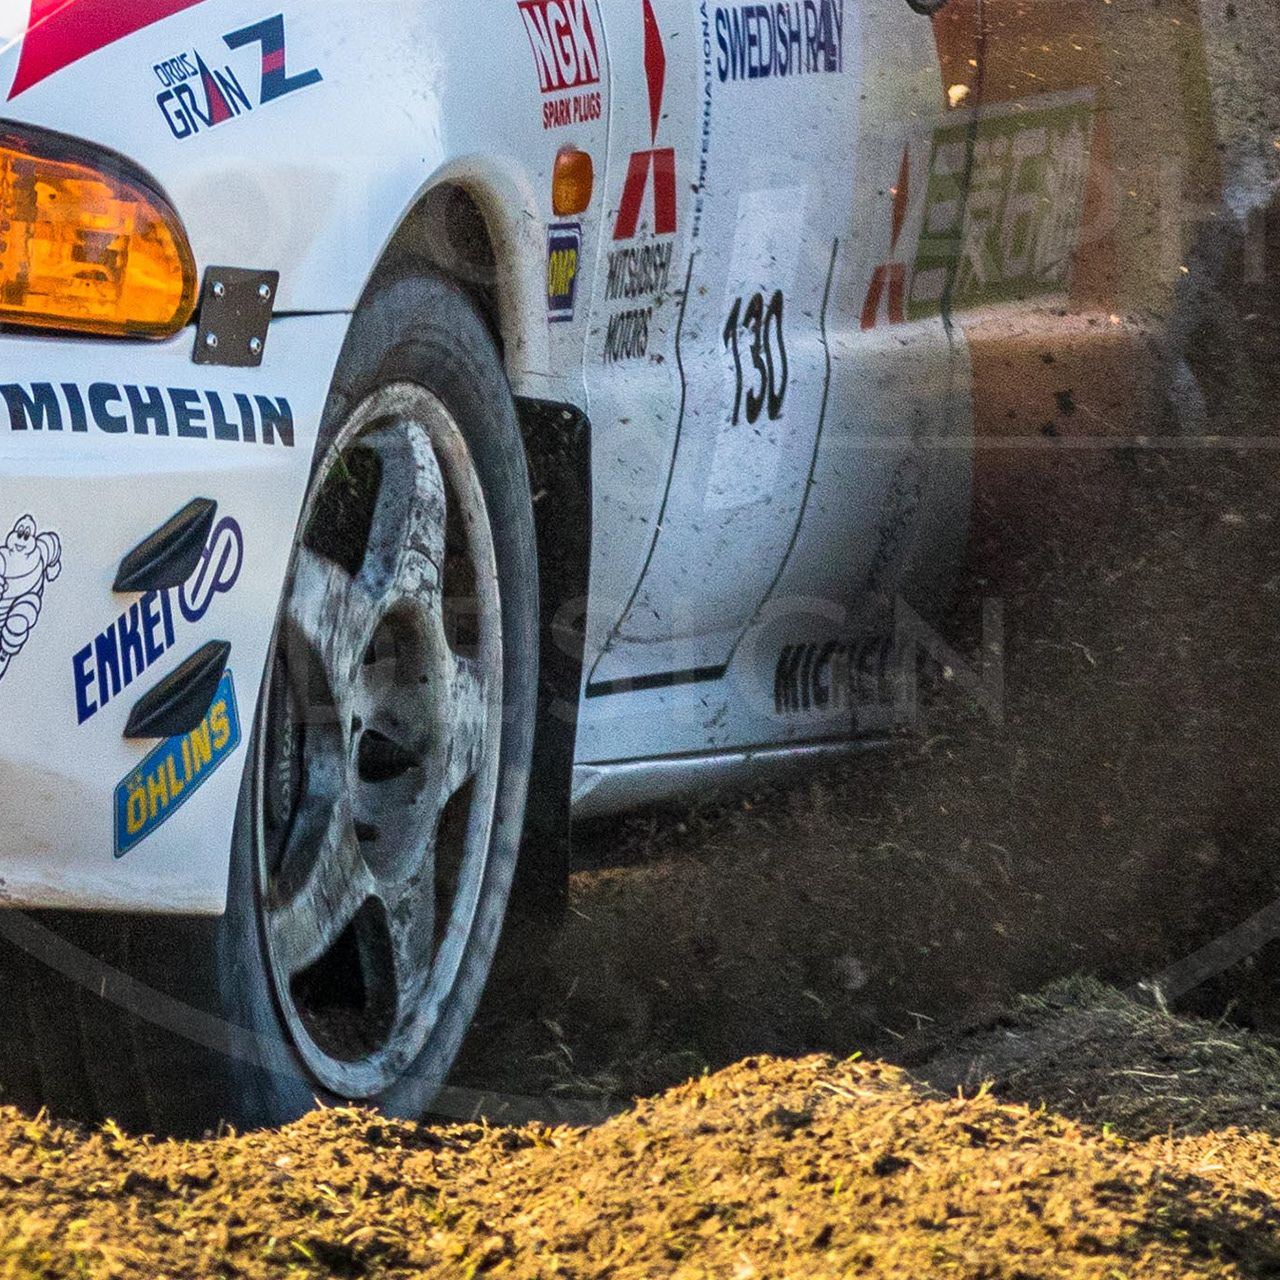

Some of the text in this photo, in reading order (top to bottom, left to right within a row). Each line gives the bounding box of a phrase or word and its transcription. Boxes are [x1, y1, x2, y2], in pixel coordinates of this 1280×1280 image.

[152, 52, 199, 88] ORBIS
[156, 12, 324, 140] GRAN Z
[714, 1, 803, 84] SWEDISH
[542, 91, 601, 130] SPARK PLUGS
[723, 288, 788, 426] 130
[72, 587, 176, 726] ENKEI
